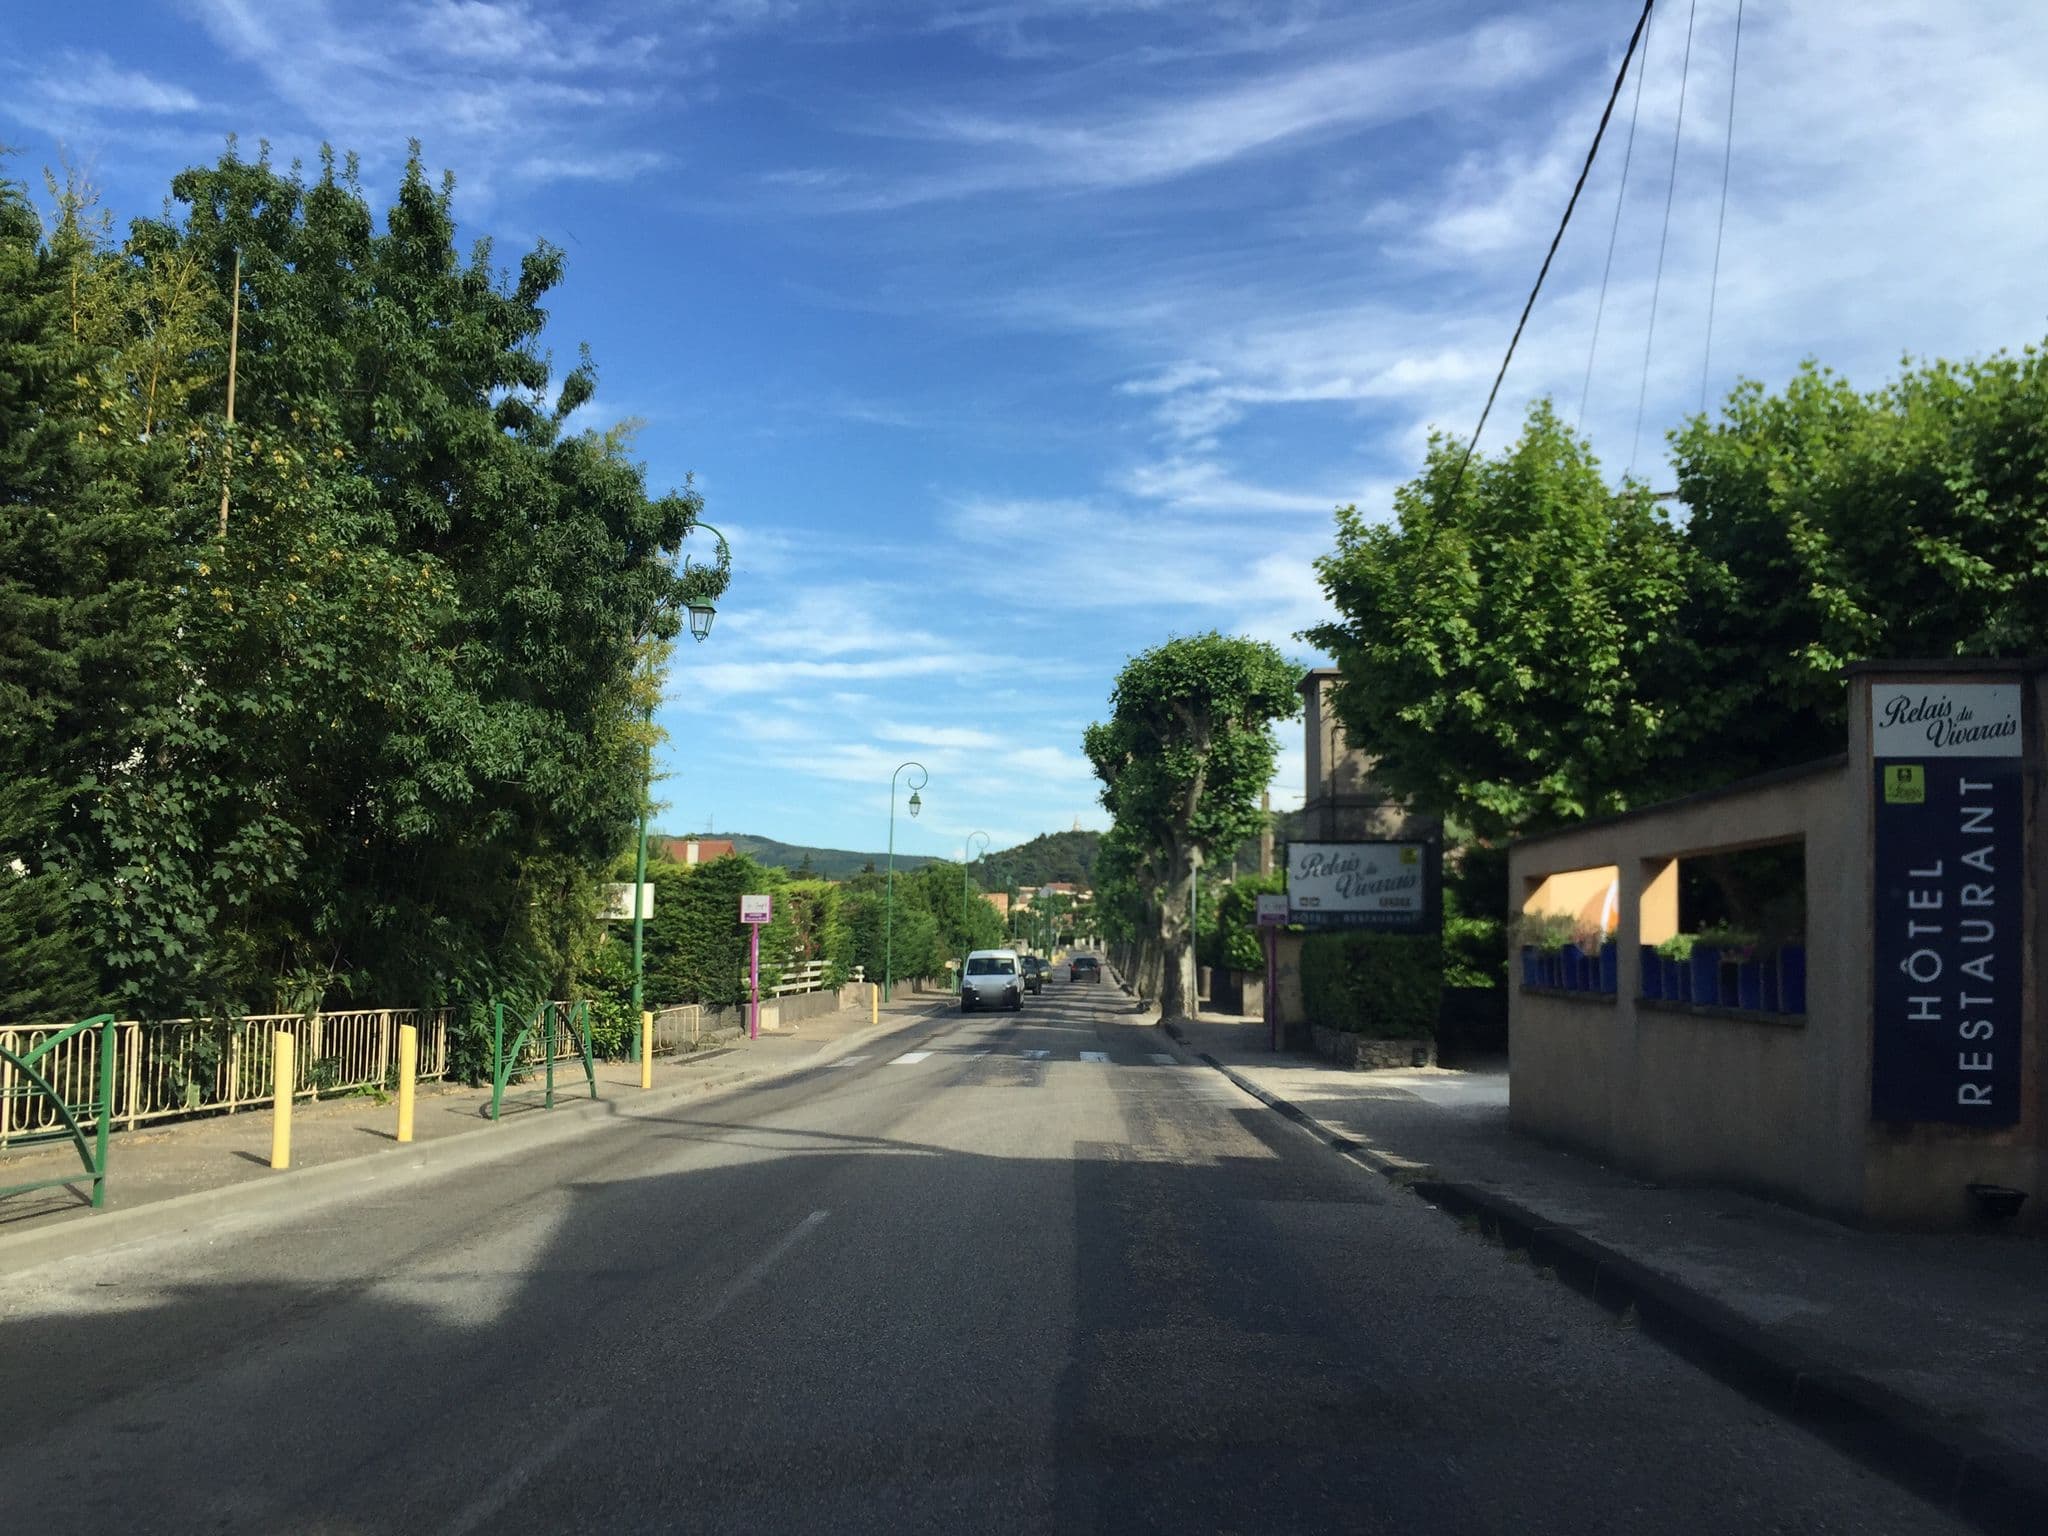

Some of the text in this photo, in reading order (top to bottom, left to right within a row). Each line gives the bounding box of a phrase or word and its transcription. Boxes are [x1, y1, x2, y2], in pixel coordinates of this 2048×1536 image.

[1879, 694, 1974, 728] Relais du
[1926, 714, 2016, 748] Vivarais
[1294, 851, 1360, 881] Relais
[1335, 869, 1416, 900] Vivarais
[1901, 859, 1943, 1021] HÔTEL
[1959, 777, 1994, 1106] RESTAURANT
